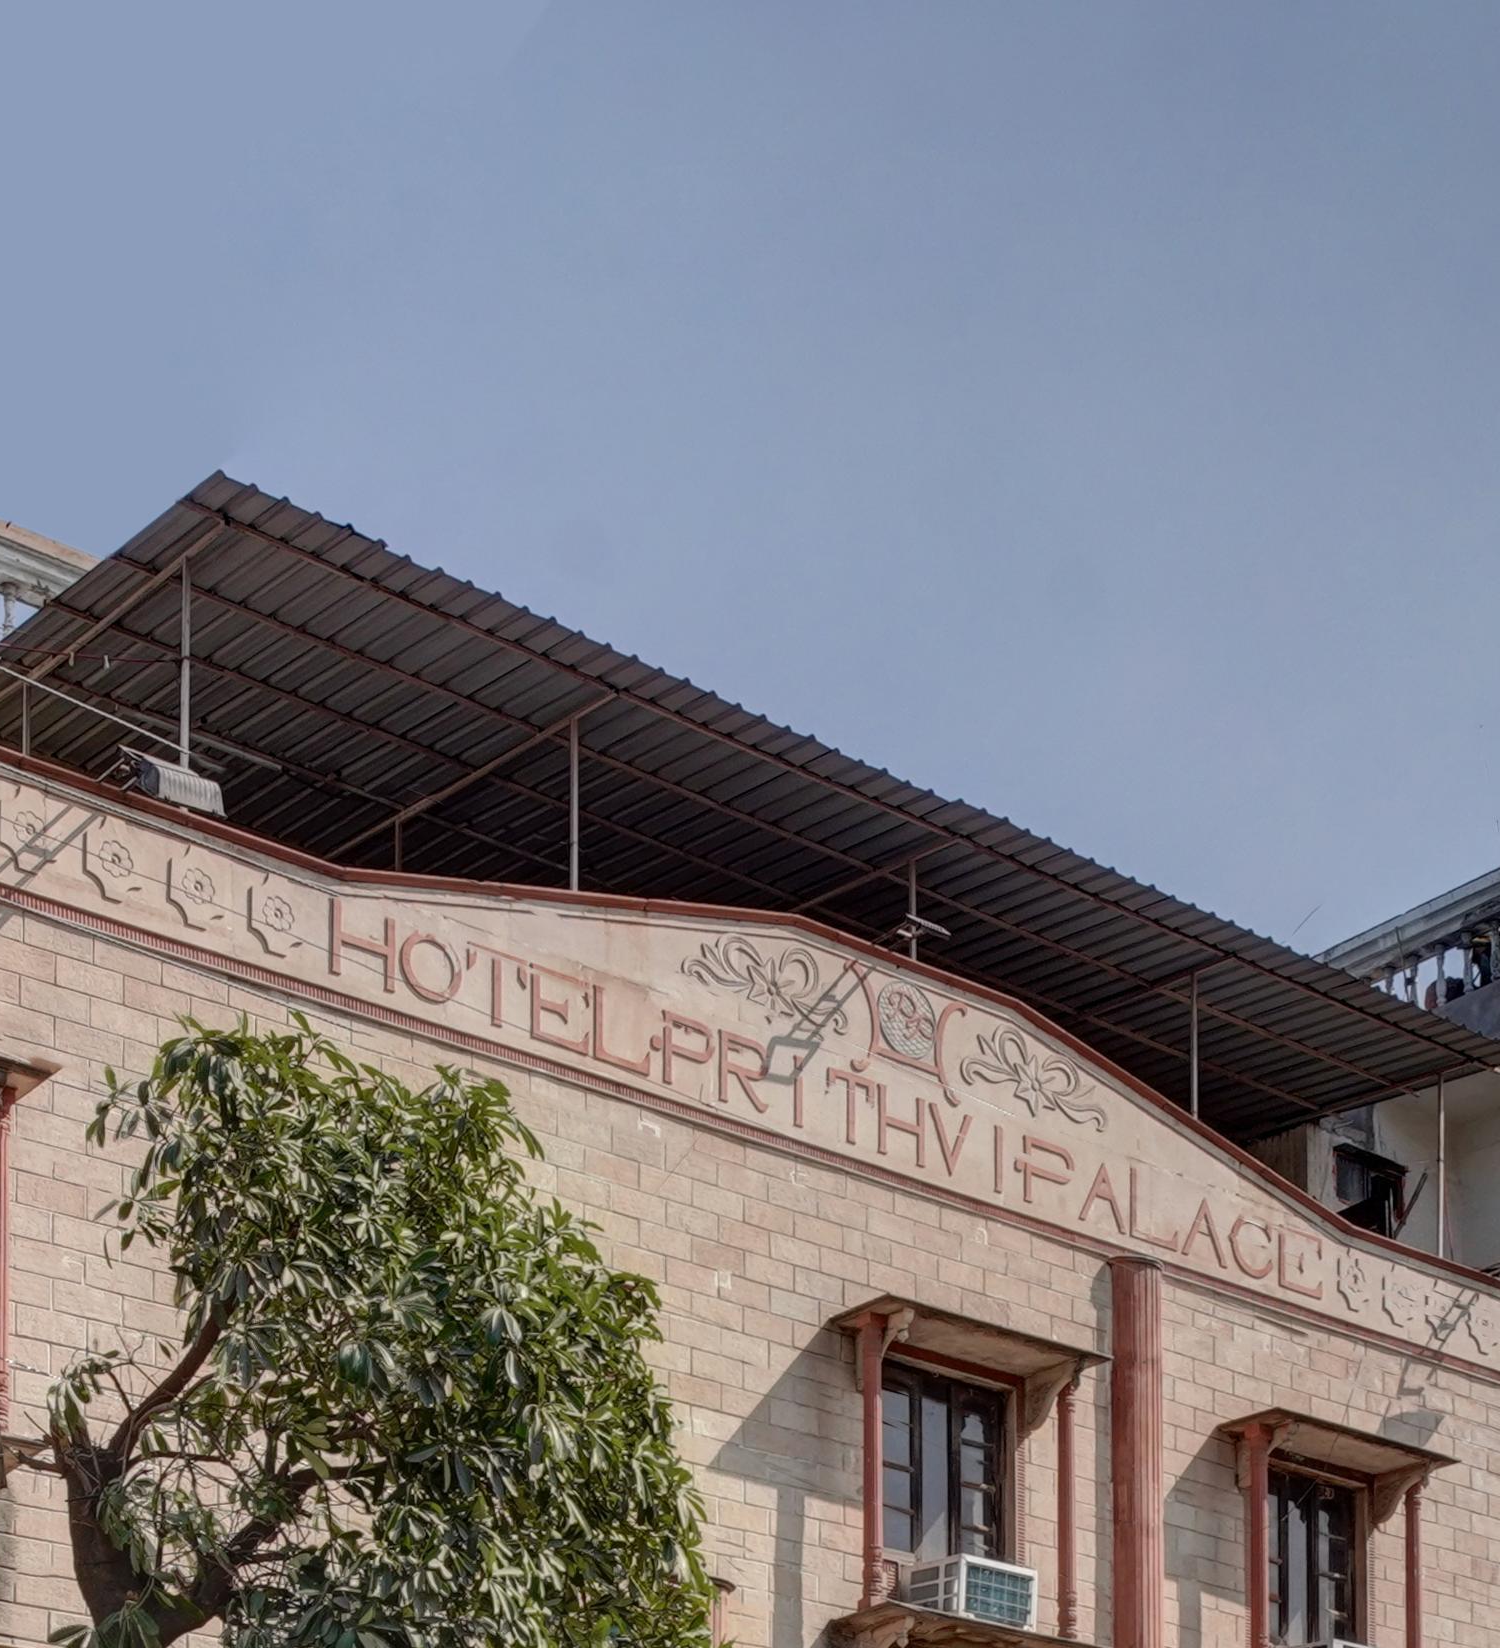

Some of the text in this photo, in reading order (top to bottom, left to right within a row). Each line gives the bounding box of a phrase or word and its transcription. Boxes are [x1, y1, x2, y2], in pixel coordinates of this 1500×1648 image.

[329, 897, 1323, 1300] HOTEL PRITHVI PALACE
